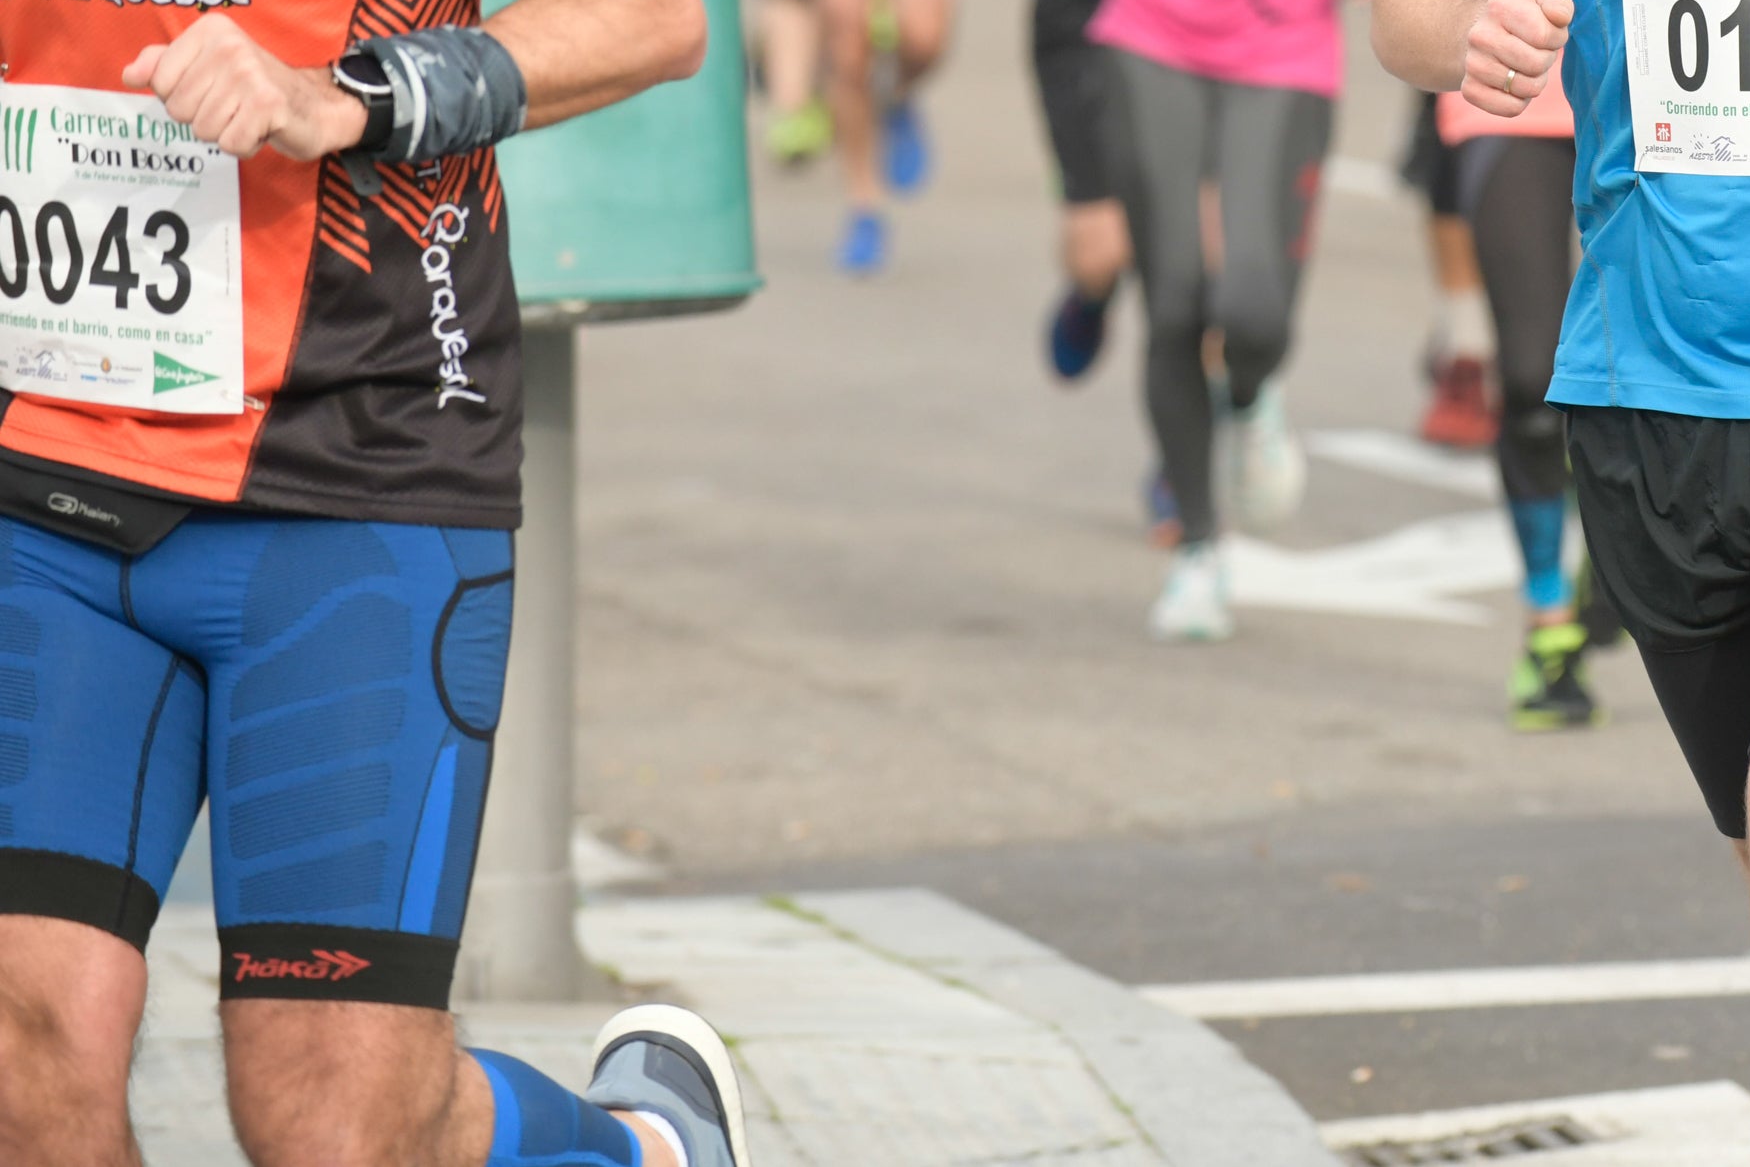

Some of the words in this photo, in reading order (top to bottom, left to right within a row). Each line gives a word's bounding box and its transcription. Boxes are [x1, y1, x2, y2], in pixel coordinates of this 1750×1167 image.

[50, 105, 129, 139] Carrera
[1722, 106, 1737, 117] en
[1645, 145, 1683, 154] salesianos
[420, 202, 487, 410] Parquesol
[41, 318, 54, 331] en
[58, 317, 69, 333] el
[72, 318, 113, 339] barrio,
[117, 325, 151, 341] como
[155, 328, 171, 342] en
